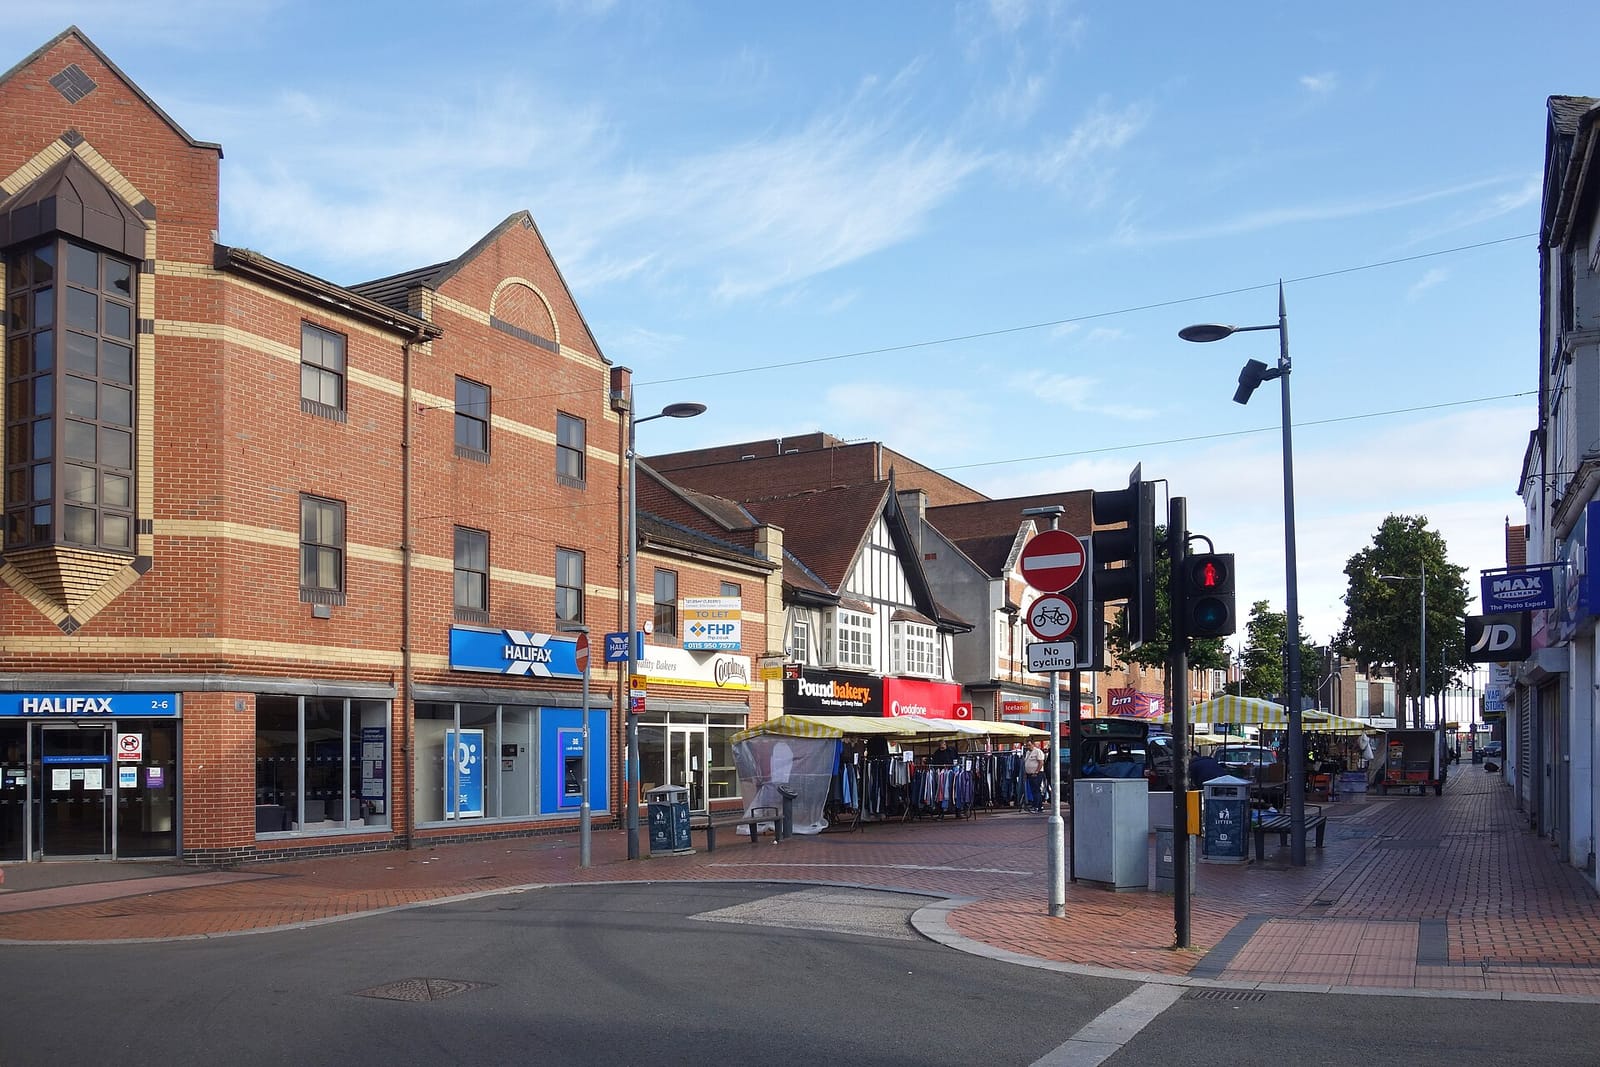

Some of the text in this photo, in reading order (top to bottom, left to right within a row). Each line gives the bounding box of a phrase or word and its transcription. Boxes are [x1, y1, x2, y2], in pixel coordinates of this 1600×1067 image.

[1493, 577, 1541, 592] MAX
[1524, 600, 1546, 608] Expert
[707, 623, 735, 635] FHP
[1470, 624, 1517, 653] JD
[505, 645, 552, 663] HALIFAX
[1043, 647, 1059, 656] No
[656, 660, 677, 671] Bakers
[1032, 657, 1071, 668] cycling
[23, 697, 168, 713] HALIFAX 2-6
[900, 703, 927, 715] vodafone
